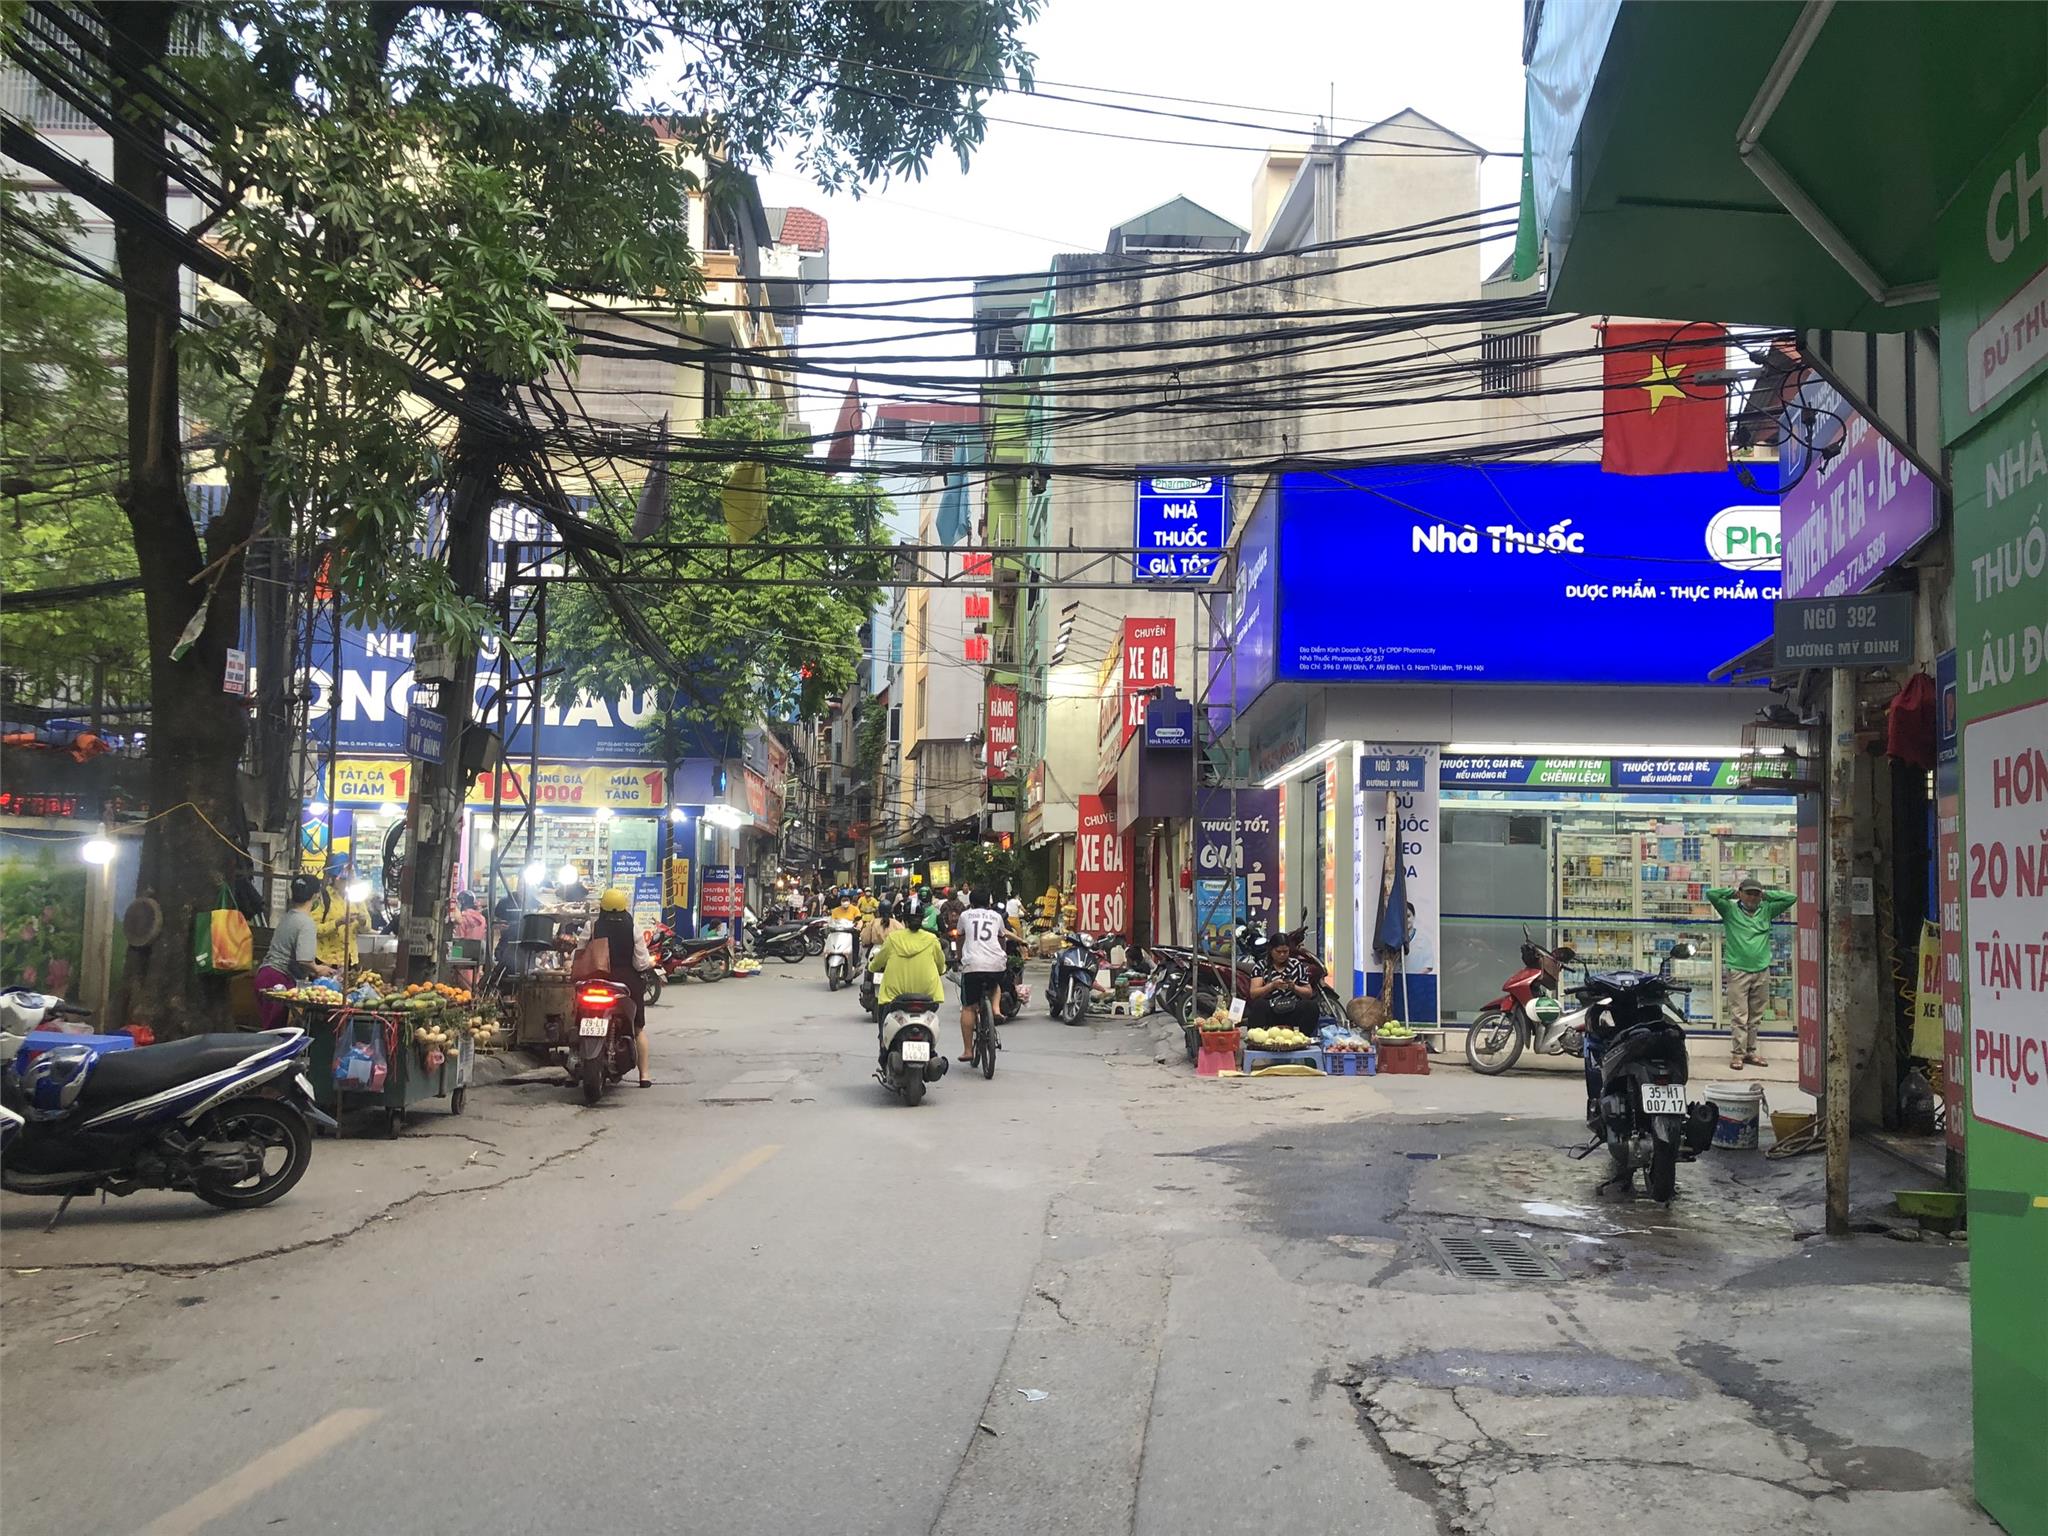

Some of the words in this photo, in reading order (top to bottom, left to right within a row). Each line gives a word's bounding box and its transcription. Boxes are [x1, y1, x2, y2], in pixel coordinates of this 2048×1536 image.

[1984, 326, 2010, 379] ĐỦ
[1986, 419, 2048, 508] NHÀ
[1163, 500, 1198, 519] NHÀ
[1831, 480, 1845, 560] XE
[1849, 459, 1866, 540] GA
[1153, 523, 1208, 547] THUỐC
[1412, 524, 1478, 554] Nhà
[1486, 518, 1585, 554] Thuốc
[1149, 554, 1176, 574] GIÁ
[1566, 584, 1608, 601] DƯỢC
[1670, 585, 1710, 602] THỰC
[1714, 579, 1757, 599] PHẨM
[1804, 604, 1837, 631] NGÕ
[1847, 605, 1876, 628] 392
[1134, 624, 1167, 639] CHUYÊN
[1785, 641, 1834, 658] ĐƯỜNG
[1864, 639, 1899, 654] ĐÌNH
[1128, 646, 1145, 680] XE
[1151, 646, 1169, 680] GA
[1967, 629, 2015, 694] LÂU
[990, 697, 1014, 717] RĂNG
[1128, 691, 1145, 726] XE
[1375, 759, 1391, 772] NGÕ
[1396, 760, 1410, 772] 394
[1471, 770, 1497, 779] KHÔNG
[1622, 758, 1655, 772] THUỐC
[1678, 758, 1694, 771] GIÁ
[389, 767, 406, 797] 1
[610, 775, 639, 786] MUA
[643, 769, 664, 805] 1
[1402, 777, 1419, 787] ĐÌNH
[1540, 769, 1578, 783] CHÊNH
[1578, 769, 1606, 785] LỆCH
[604, 789, 639, 801] TẶNG
[1244, 814, 1270, 834] TỐT,
[1080, 833, 1100, 872] XE
[1103, 833, 1124, 872] GA
[1200, 837, 1244, 869] GIÁ
[1970, 842, 2008, 899] 20
[1080, 893, 1100, 931] XE
[1103, 881, 1126, 932] SỐ
[972, 919, 993, 942] 15
[1975, 929, 2022, 1000] TẬN
[1923, 1003, 1936, 1018] XE
[1975, 1029, 2040, 1093] PHỤC
[1649, 1086, 1679, 1099] 35-H1
[1646, 1099, 1684, 1113] 007.17
